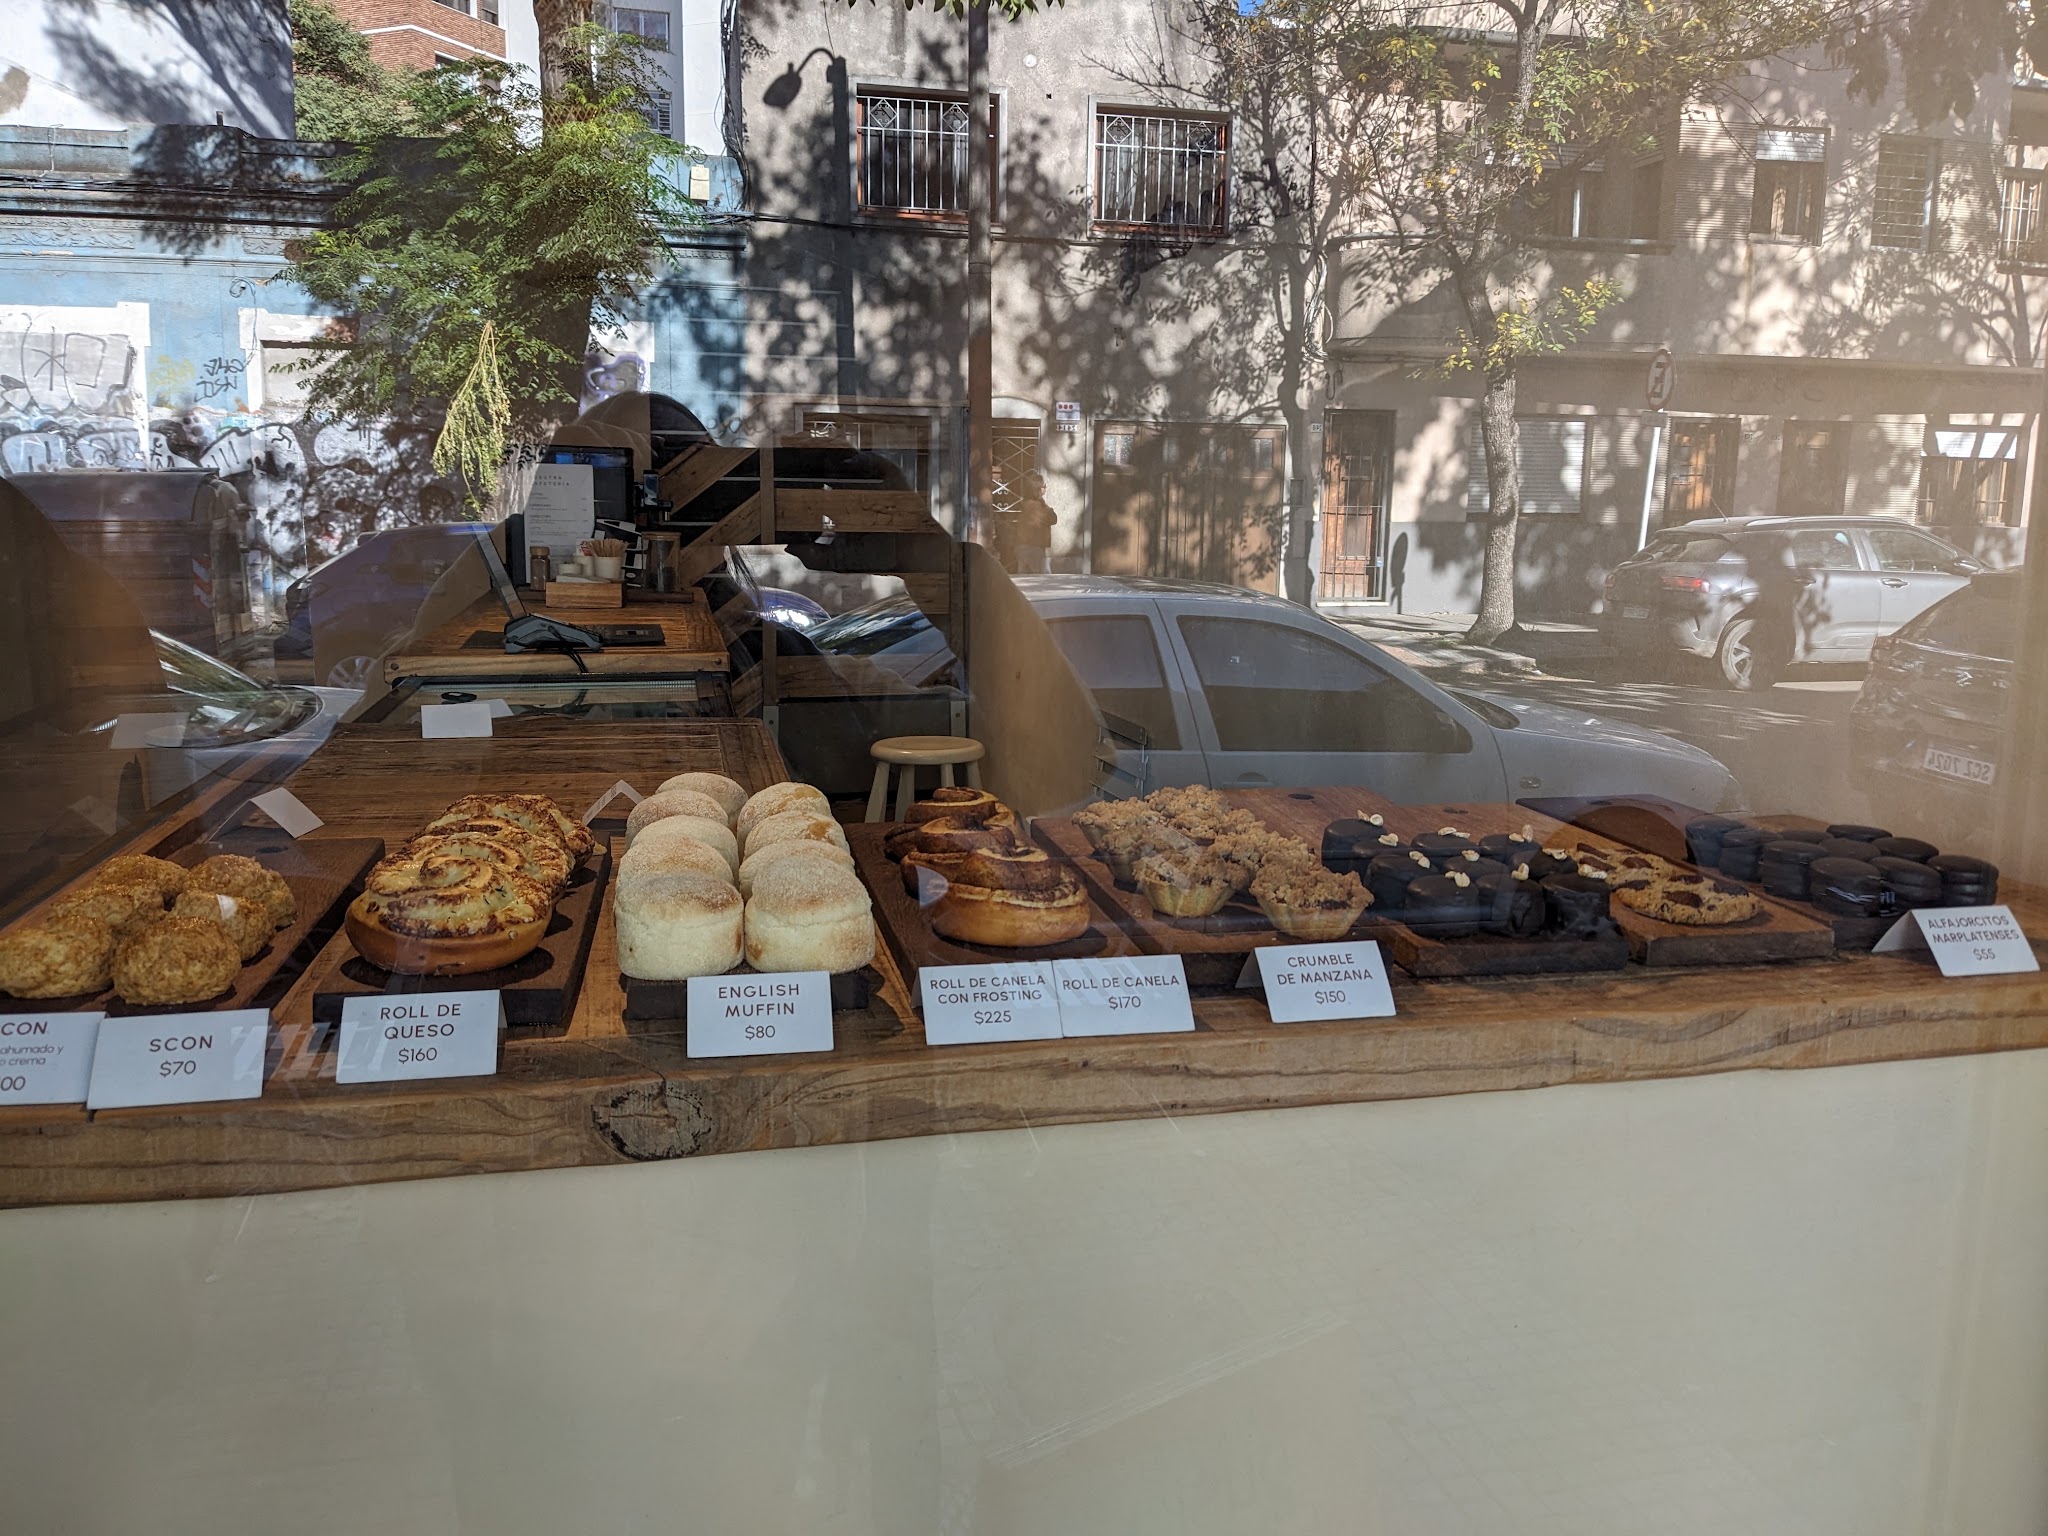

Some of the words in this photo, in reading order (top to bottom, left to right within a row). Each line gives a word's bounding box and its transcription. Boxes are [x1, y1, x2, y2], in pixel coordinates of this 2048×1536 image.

[1927, 915, 2010, 930] ALFAJORCITOS
[1932, 929, 2020, 944] MARPLATENSES
[1287, 953, 1355, 968] CRUMBLE
[1973, 948, 1996, 961] $55
[930, 977, 963, 990] ROLL
[969, 976, 987, 988] DE
[990, 974, 1047, 987] CANELA
[1062, 977, 1099, 991] ROLL
[1102, 976, 1120, 988] DE
[1123, 974, 1180, 988] CANELA
[1277, 973, 1297, 986] DE
[1300, 968, 1374, 985] MANZANA
[718, 983, 800, 999] ENGLISH
[937, 992, 969, 1005] CON
[973, 989, 1043, 1003] FROSTING
[1314, 990, 1347, 1006] $150
[725, 1002, 795, 1018] MUFFIN
[1107, 995, 1142, 1010] $170
[380, 1005, 429, 1020] ROLL
[437, 1003, 462, 1017] DE
[973, 1010, 1012, 1026] $225
[384, 1023, 455, 1040] QUESO
[744, 1024, 776, 1041] $80
[56, 1045, 64, 1055] y
[150, 1034, 214, 1053] SCON
[8, 1056, 47, 1066] crema
[398, 1047, 438, 1065] $160
[159, 1060, 197, 1078] $70
